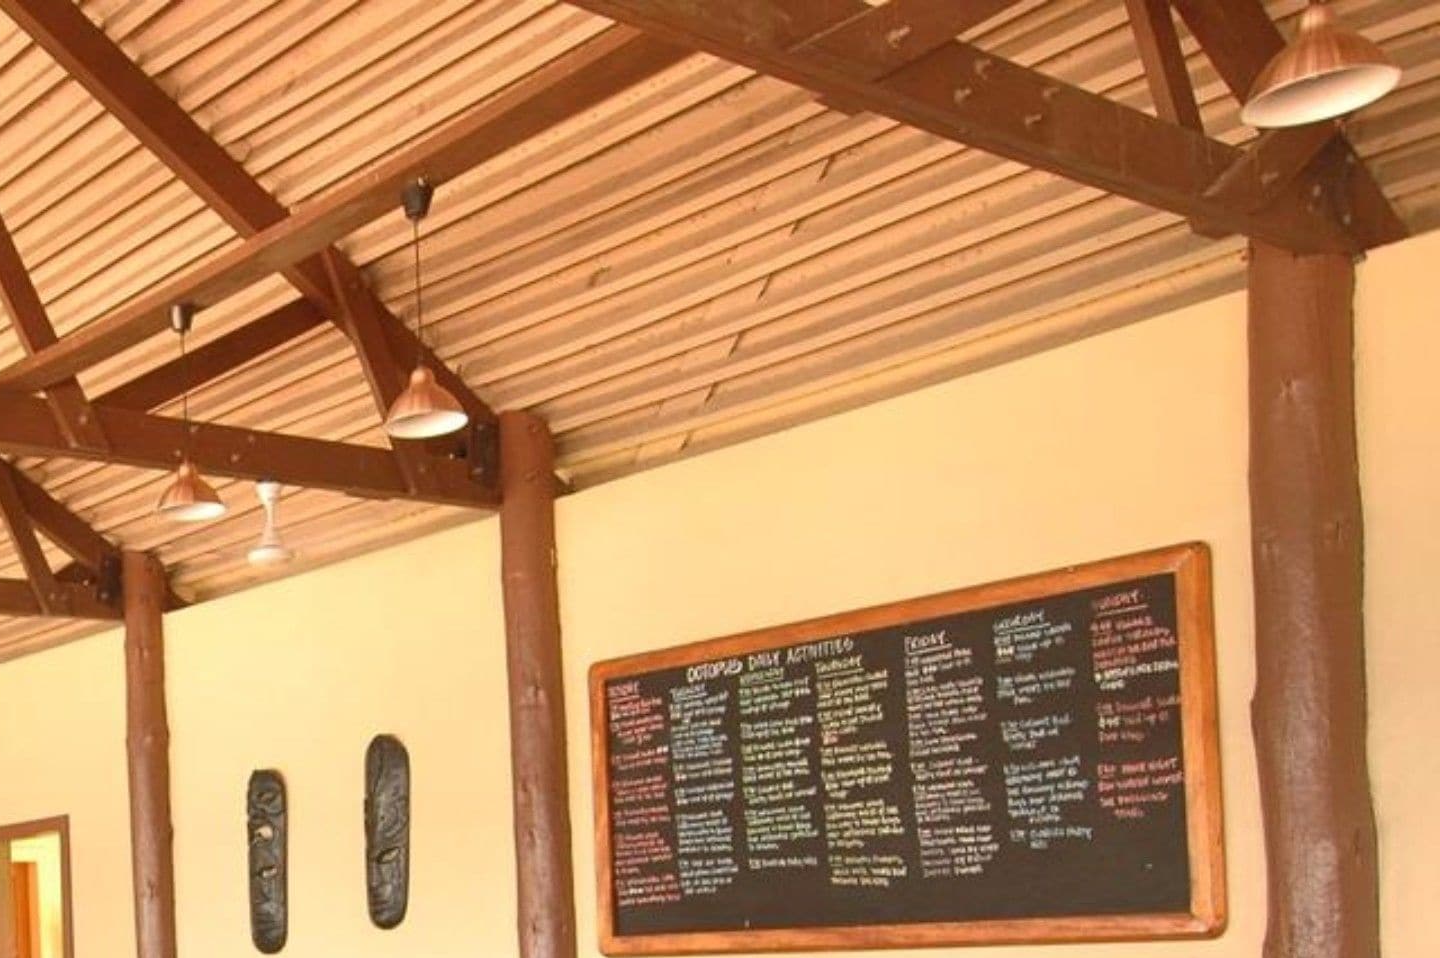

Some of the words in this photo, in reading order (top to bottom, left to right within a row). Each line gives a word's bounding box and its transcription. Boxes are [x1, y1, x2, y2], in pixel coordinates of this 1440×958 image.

[904, 630, 946, 652] FRIDAY
[686, 660, 743, 683] OCTOPUS
[748, 651, 780, 671] DAILY
[786, 637, 854, 664] ACTIVITIES
